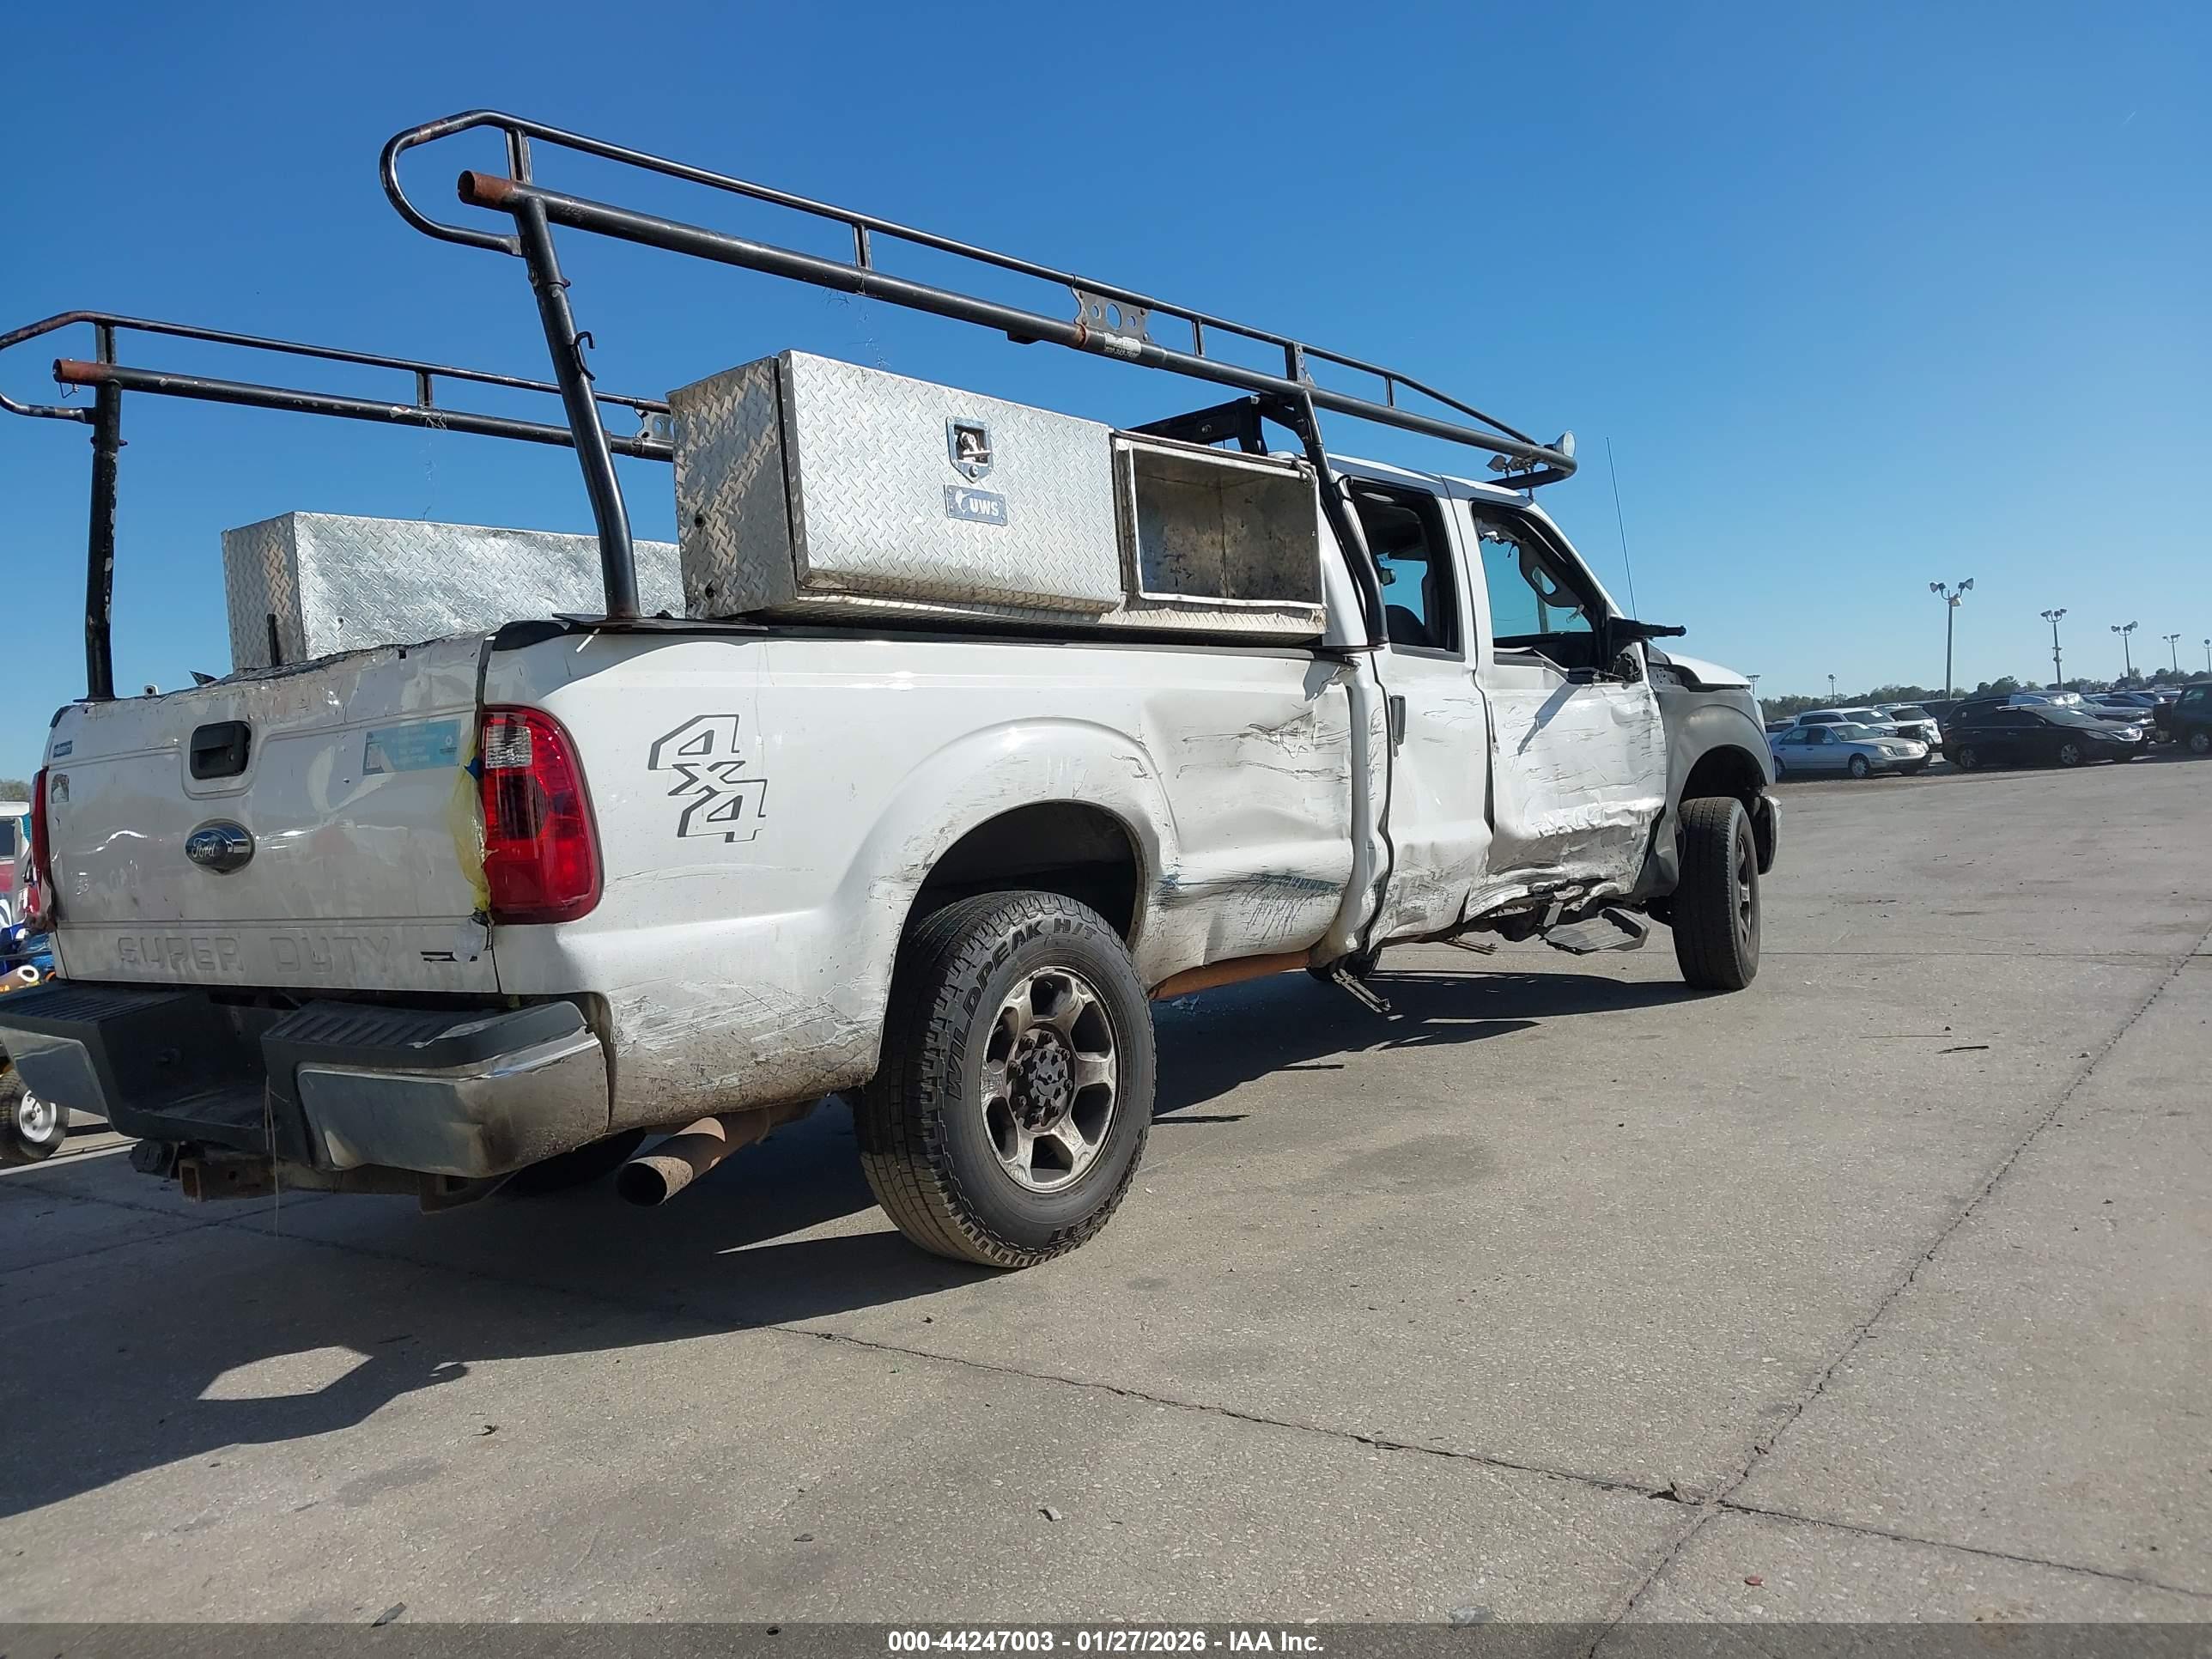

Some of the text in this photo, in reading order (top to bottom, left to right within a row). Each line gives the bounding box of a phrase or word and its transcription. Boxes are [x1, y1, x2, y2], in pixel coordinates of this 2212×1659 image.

[969, 497, 1000, 516] UWS
[191, 837, 216, 858] Ford
[117, 936, 392, 974] SUPER DUTY
[946, 919, 1044, 1101] WILDPEAK
